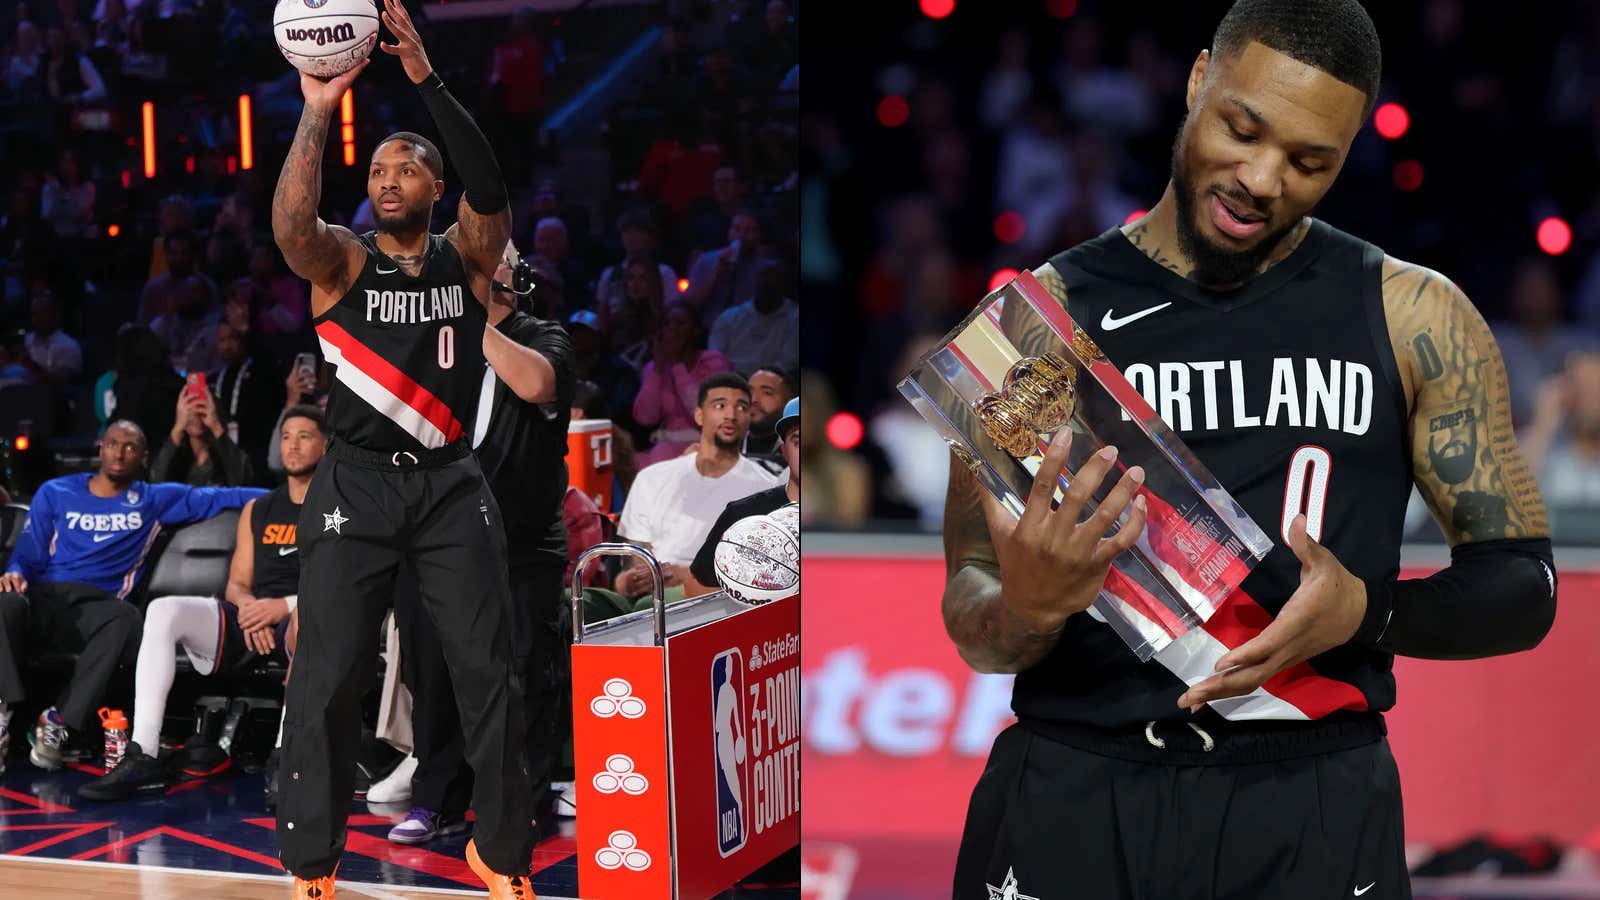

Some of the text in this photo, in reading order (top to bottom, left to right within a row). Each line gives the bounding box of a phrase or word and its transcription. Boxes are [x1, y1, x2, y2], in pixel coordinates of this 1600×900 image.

[285, 22, 356, 46] Wilson
[364, 285, 464, 324] PORTLAND
[437, 325, 455, 370] 0
[1121, 357, 1374, 436] ORTLAND
[1281, 444, 1333, 548] 0
[66, 511, 143, 531] 76ERS
[1199, 536, 1243, 586] CHAMPION
[722, 807, 738, 844] NBA
